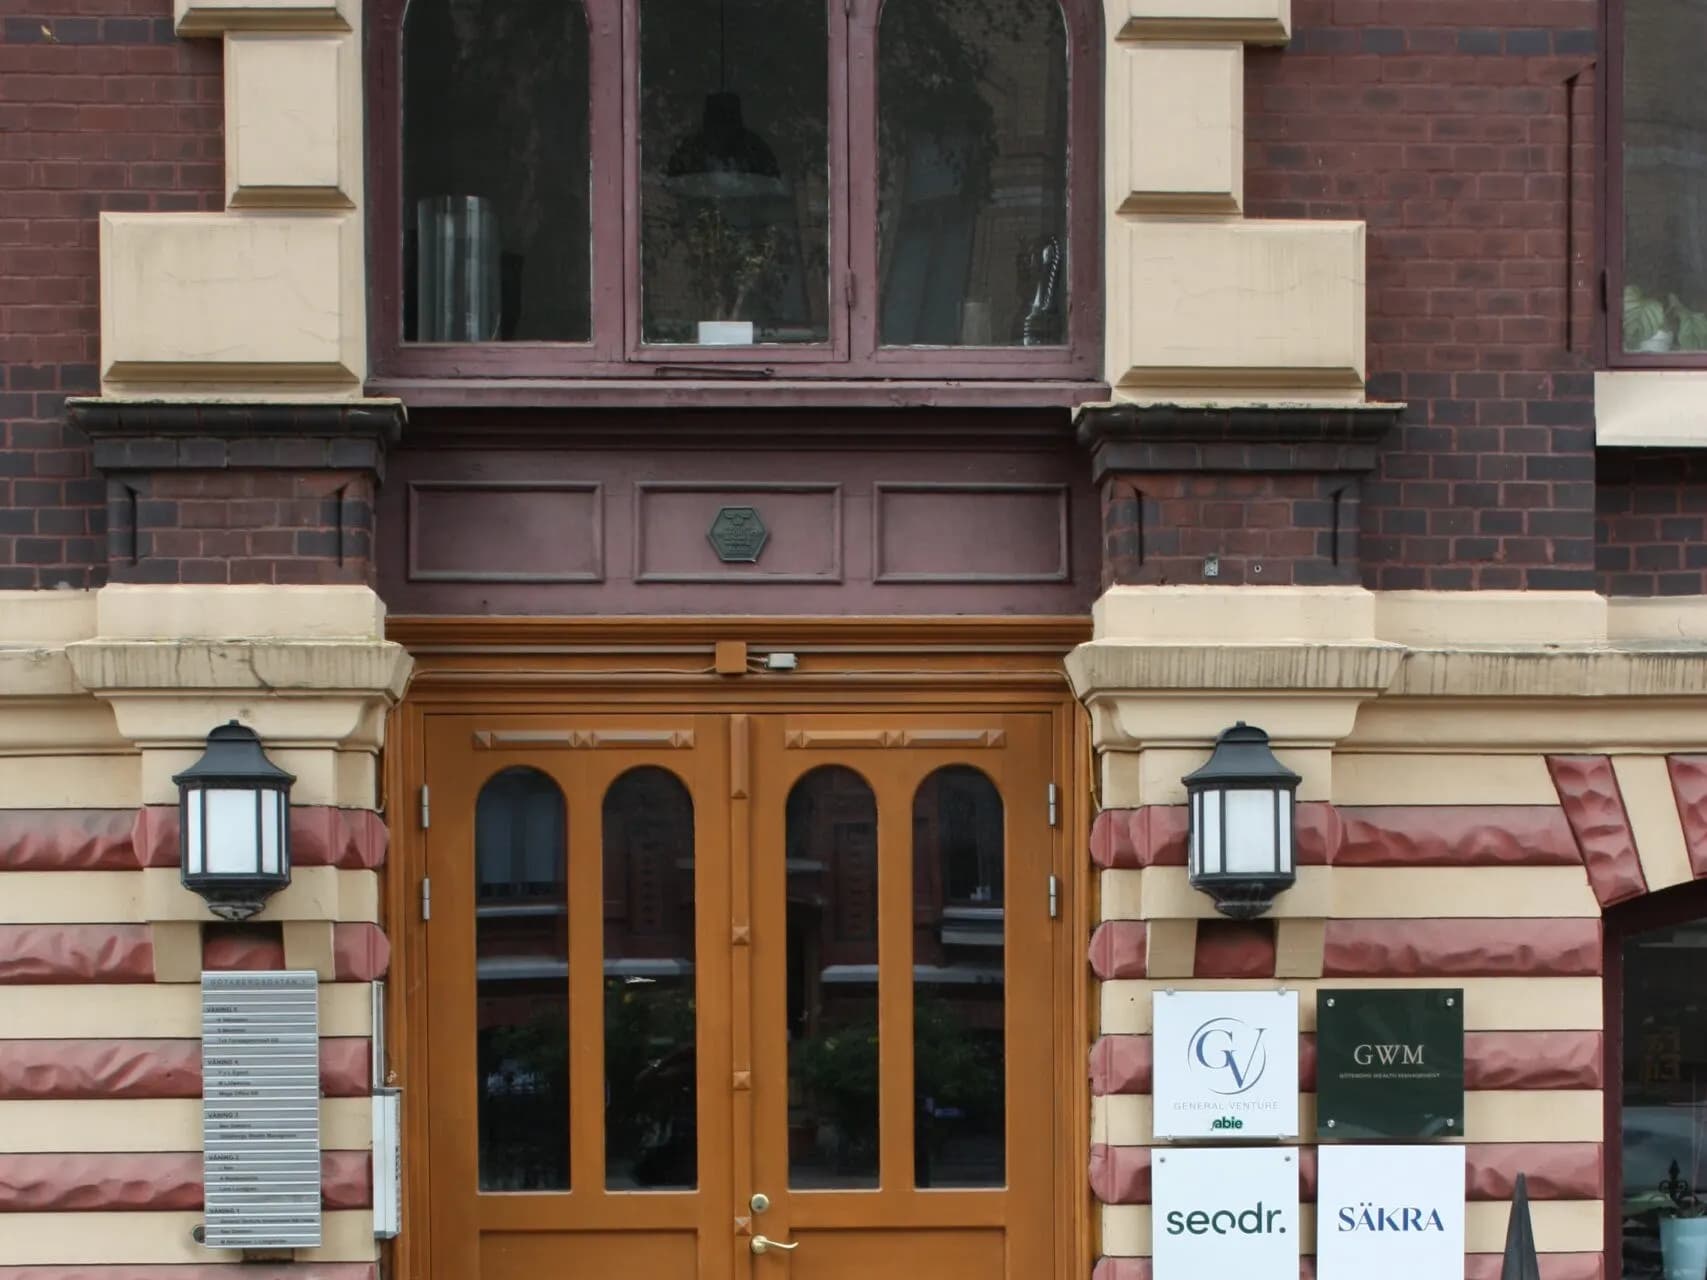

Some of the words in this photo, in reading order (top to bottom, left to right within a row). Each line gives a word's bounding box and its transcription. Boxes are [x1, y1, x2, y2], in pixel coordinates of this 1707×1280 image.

[1196, 1028, 1267, 1088] GV
[1353, 1044, 1425, 1065] GWM
[1173, 1102, 1224, 1111] GENERAL
[1230, 1101, 1281, 1110] VENTURE
[1338, 1202, 1445, 1232] SÄKRA
